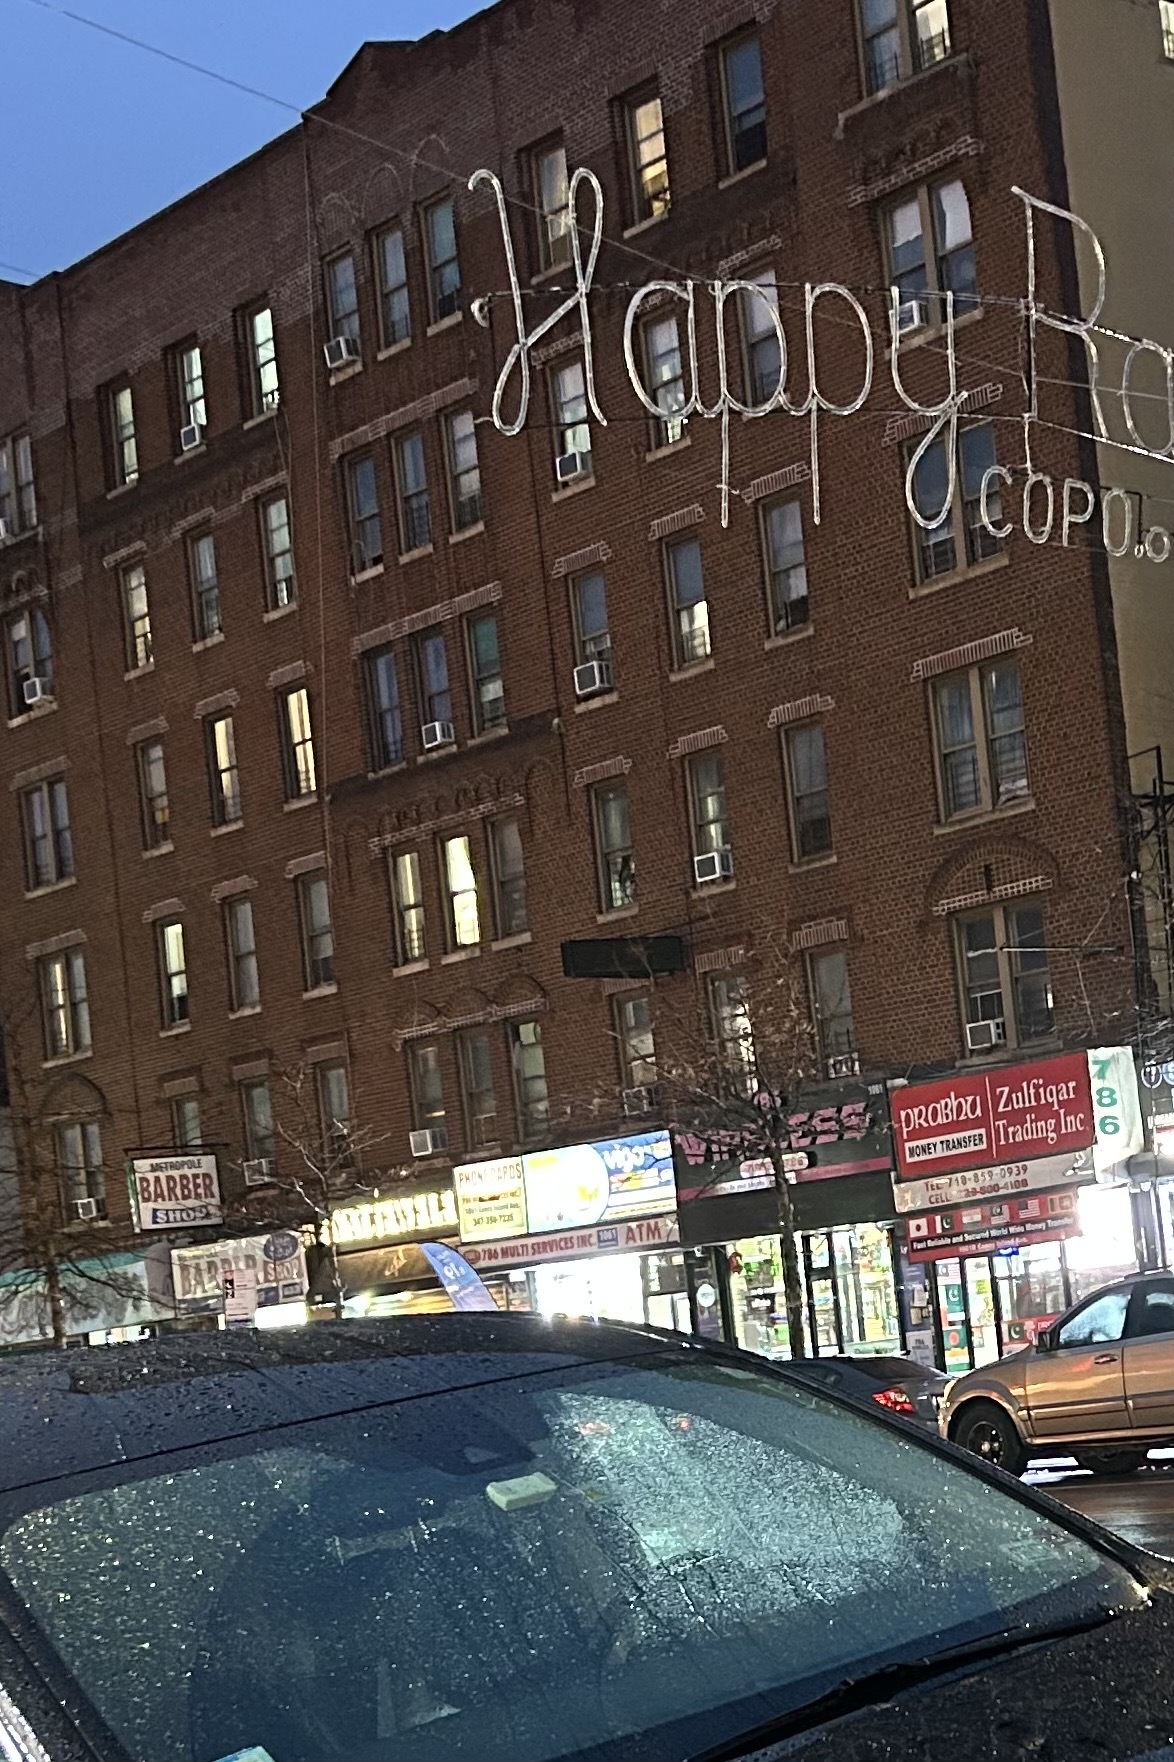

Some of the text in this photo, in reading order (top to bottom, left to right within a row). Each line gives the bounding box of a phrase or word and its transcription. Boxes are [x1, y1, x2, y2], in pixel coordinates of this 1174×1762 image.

[469, 167, 968, 529] Happy
[996, 1078, 1077, 1112] Zulfiqar
[995, 1114, 1057, 1146] Trading
[908, 1133, 984, 1160] MONEY TRANSFER
[150, 1158, 202, 1173] METROPOLE
[139, 1173, 215, 1203] BARBER
[625, 1221, 662, 1245] ATM
[480, 1245, 499, 1261] 786
[501, 1243, 529, 1259] MULTI
[531, 1237, 575, 1256] SERVICES
